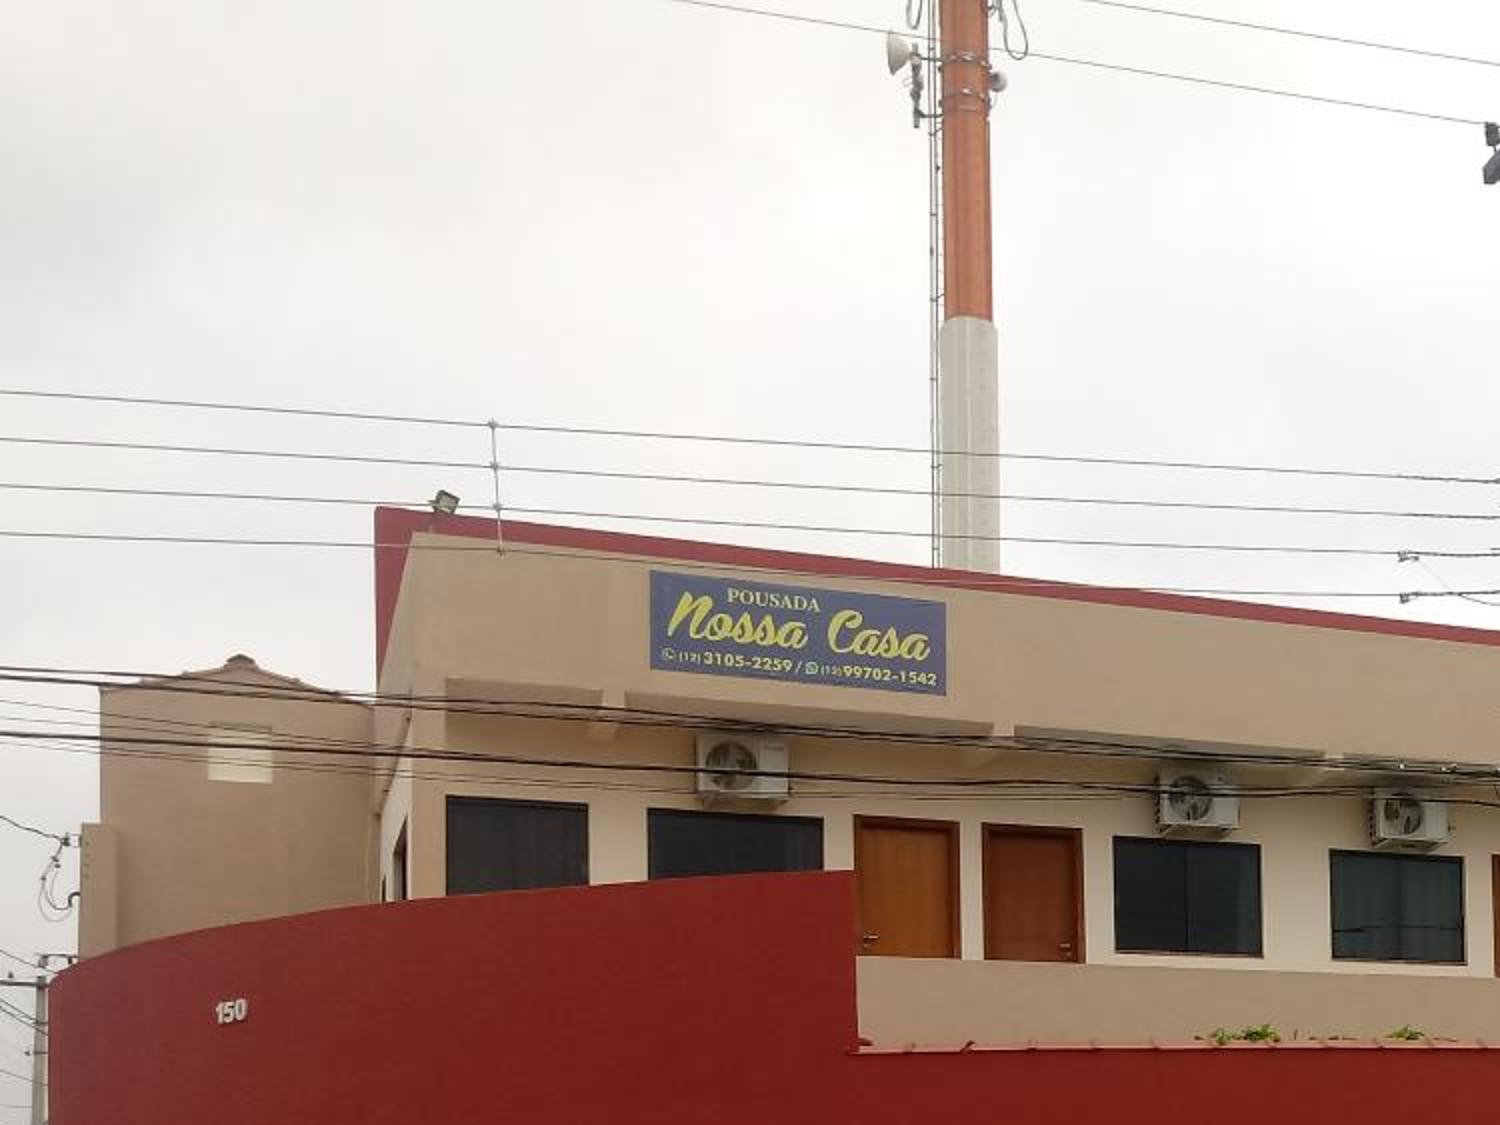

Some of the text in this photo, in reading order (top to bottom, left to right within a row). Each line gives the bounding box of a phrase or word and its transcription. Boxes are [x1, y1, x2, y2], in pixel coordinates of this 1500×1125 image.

[727, 587, 821, 613] POUSADA
[666, 591, 931, 661] Nossa Casa
[703, 651, 793, 673] 3105-2259
[216, 998, 248, 1024] 150
